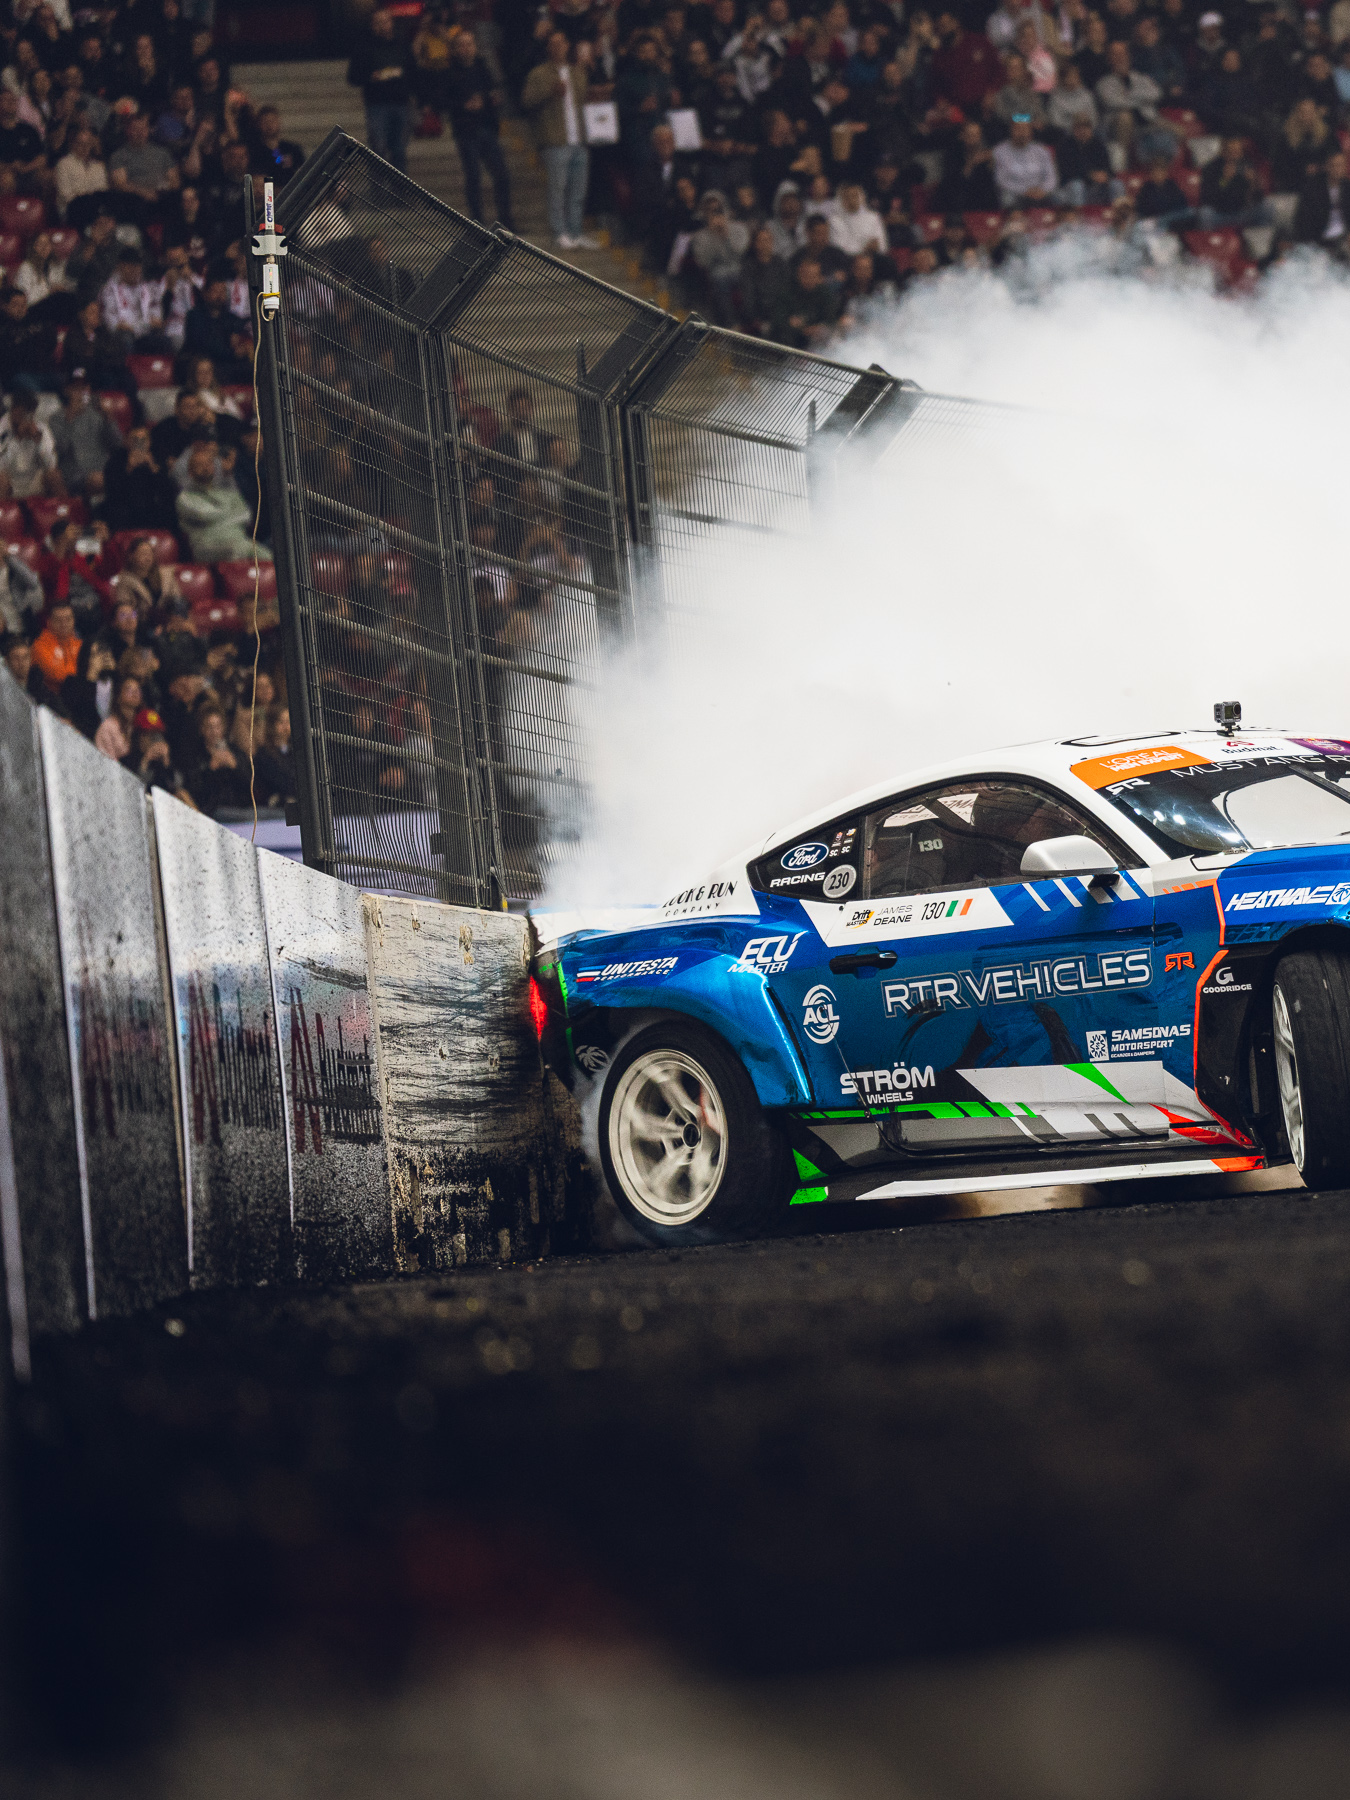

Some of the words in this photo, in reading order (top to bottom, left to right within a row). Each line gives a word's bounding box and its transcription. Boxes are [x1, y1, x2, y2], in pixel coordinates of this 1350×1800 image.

[918, 838, 943, 852] 130
[788, 846, 821, 867] Ford
[770, 872, 826, 888] RACING
[828, 872, 849, 890] 230
[707, 881, 738, 899] RUN
[1225, 885, 1335, 912] HEATWAVE
[665, 902, 720, 917] COMPANY
[852, 909, 871, 921] Drift
[877, 904, 913, 916] JAMES
[921, 901, 945, 921] 130
[873, 914, 912, 926] DEANE
[737, 930, 809, 965] ECU
[601, 957, 679, 976] UNITESTA
[727, 961, 788, 974] MASTER
[593, 969, 670, 982] PERFORMANCE
[884, 975, 964, 1014] RTR
[963, 951, 1151, 1003] VEHICLES
[1203, 983, 1252, 994] GOODRIDGE
[803, 1011, 840, 1026] ACL
[1111, 1024, 1191, 1041] SAMSONAS
[1111, 1040, 1174, 1052] MOTORSPORT
[840, 1061, 935, 1095] STRÖM
[866, 1092, 913, 1105] WHEELS
